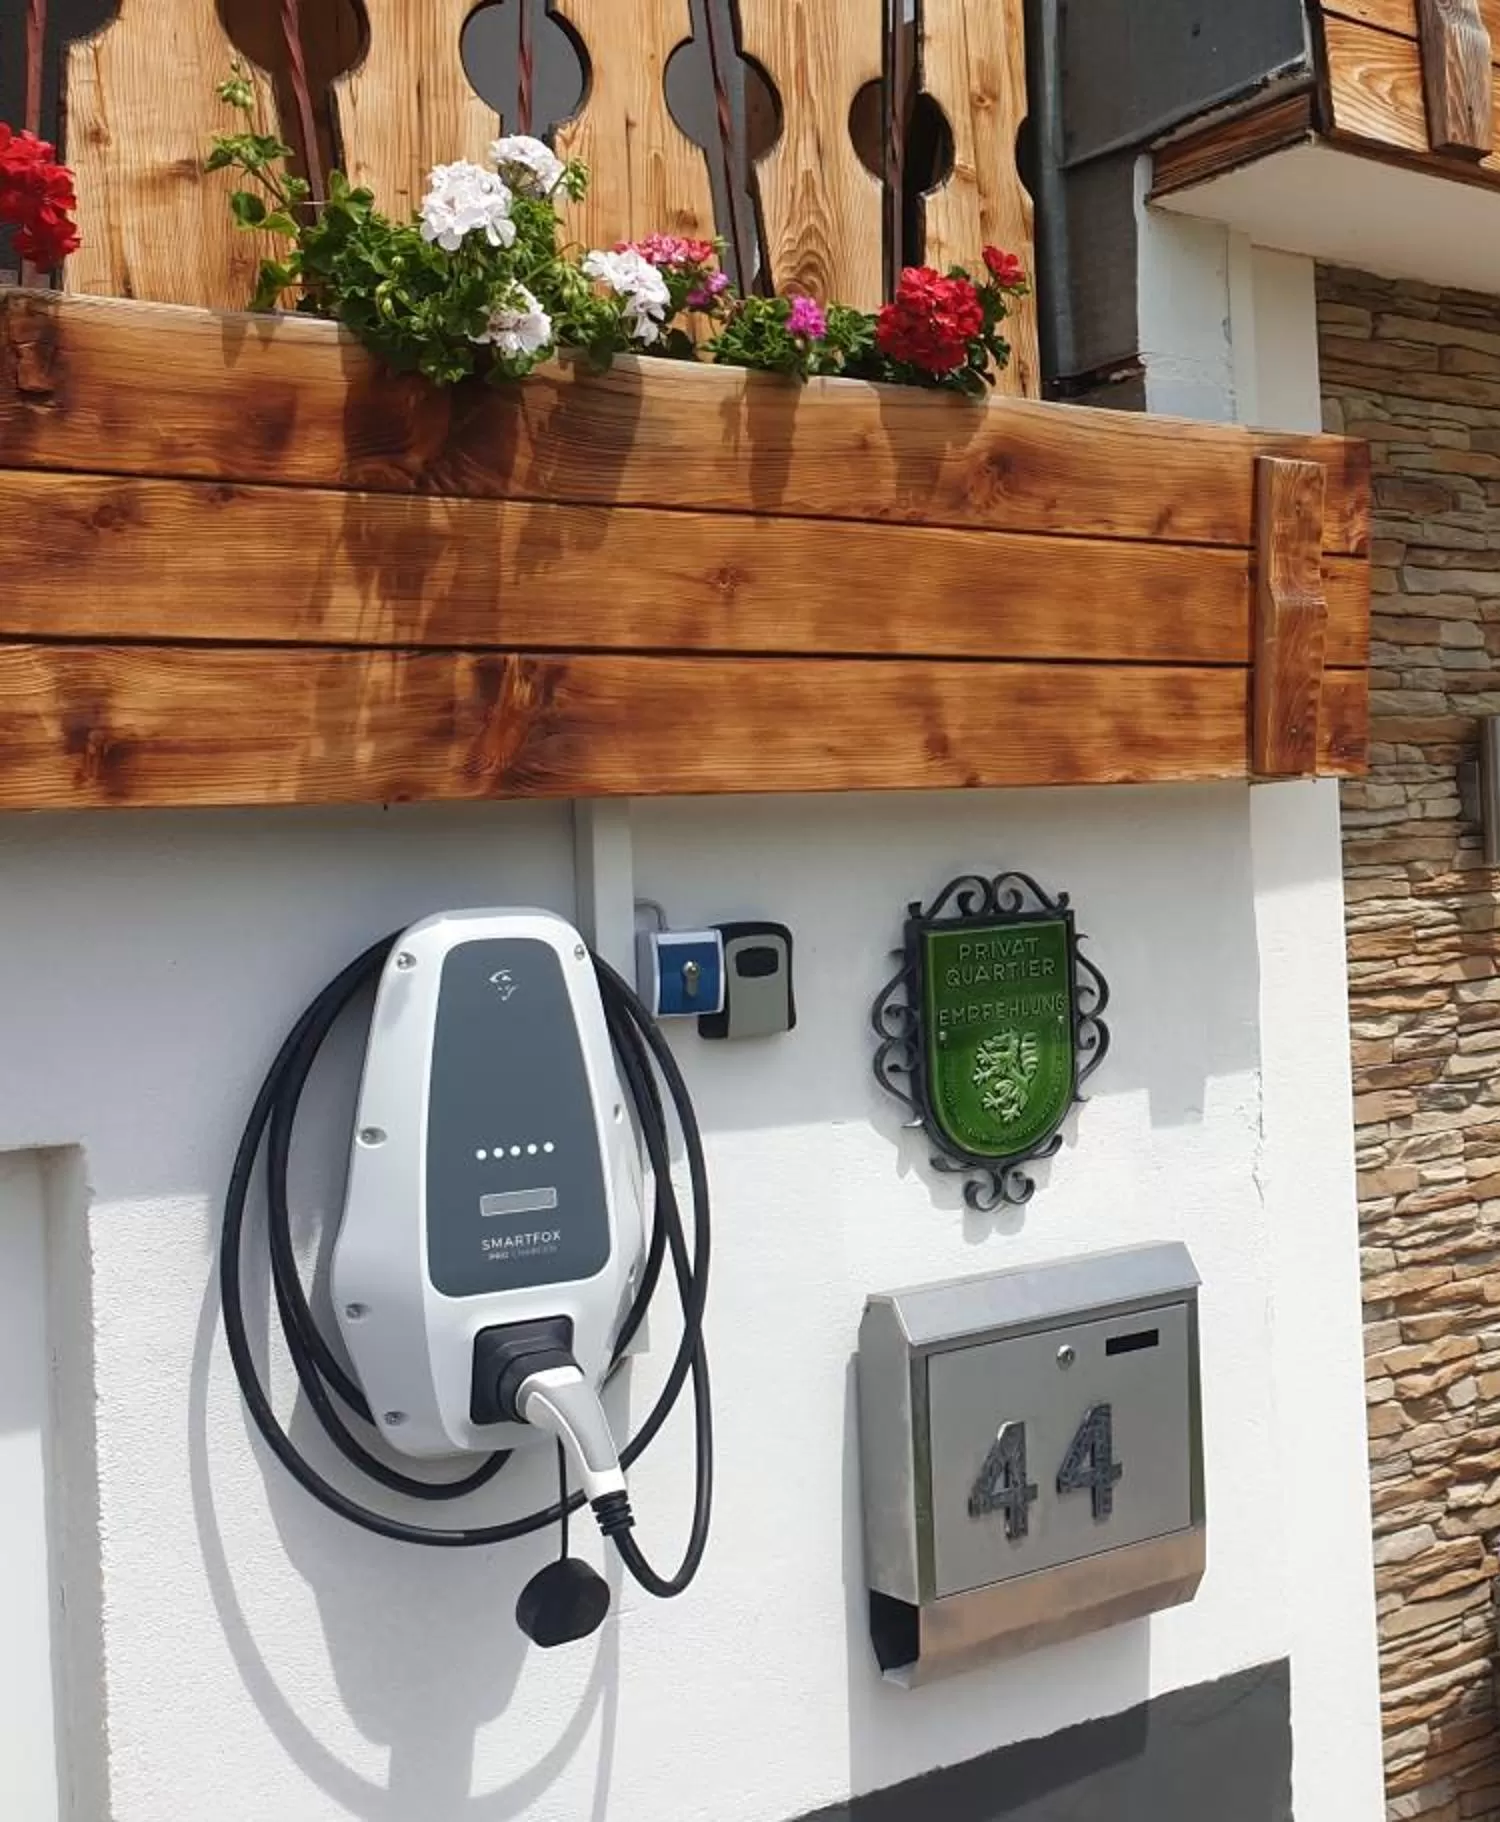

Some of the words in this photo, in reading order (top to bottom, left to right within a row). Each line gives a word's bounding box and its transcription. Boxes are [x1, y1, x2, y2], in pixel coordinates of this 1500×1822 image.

[959, 937, 1040, 961] PRIVAT
[946, 958, 1056, 987] QUARTIER
[938, 993, 1066, 1026] EMPFEHLUNG
[481, 1230, 561, 1251] SMARTFOX
[967, 1402, 1123, 1541] 44
